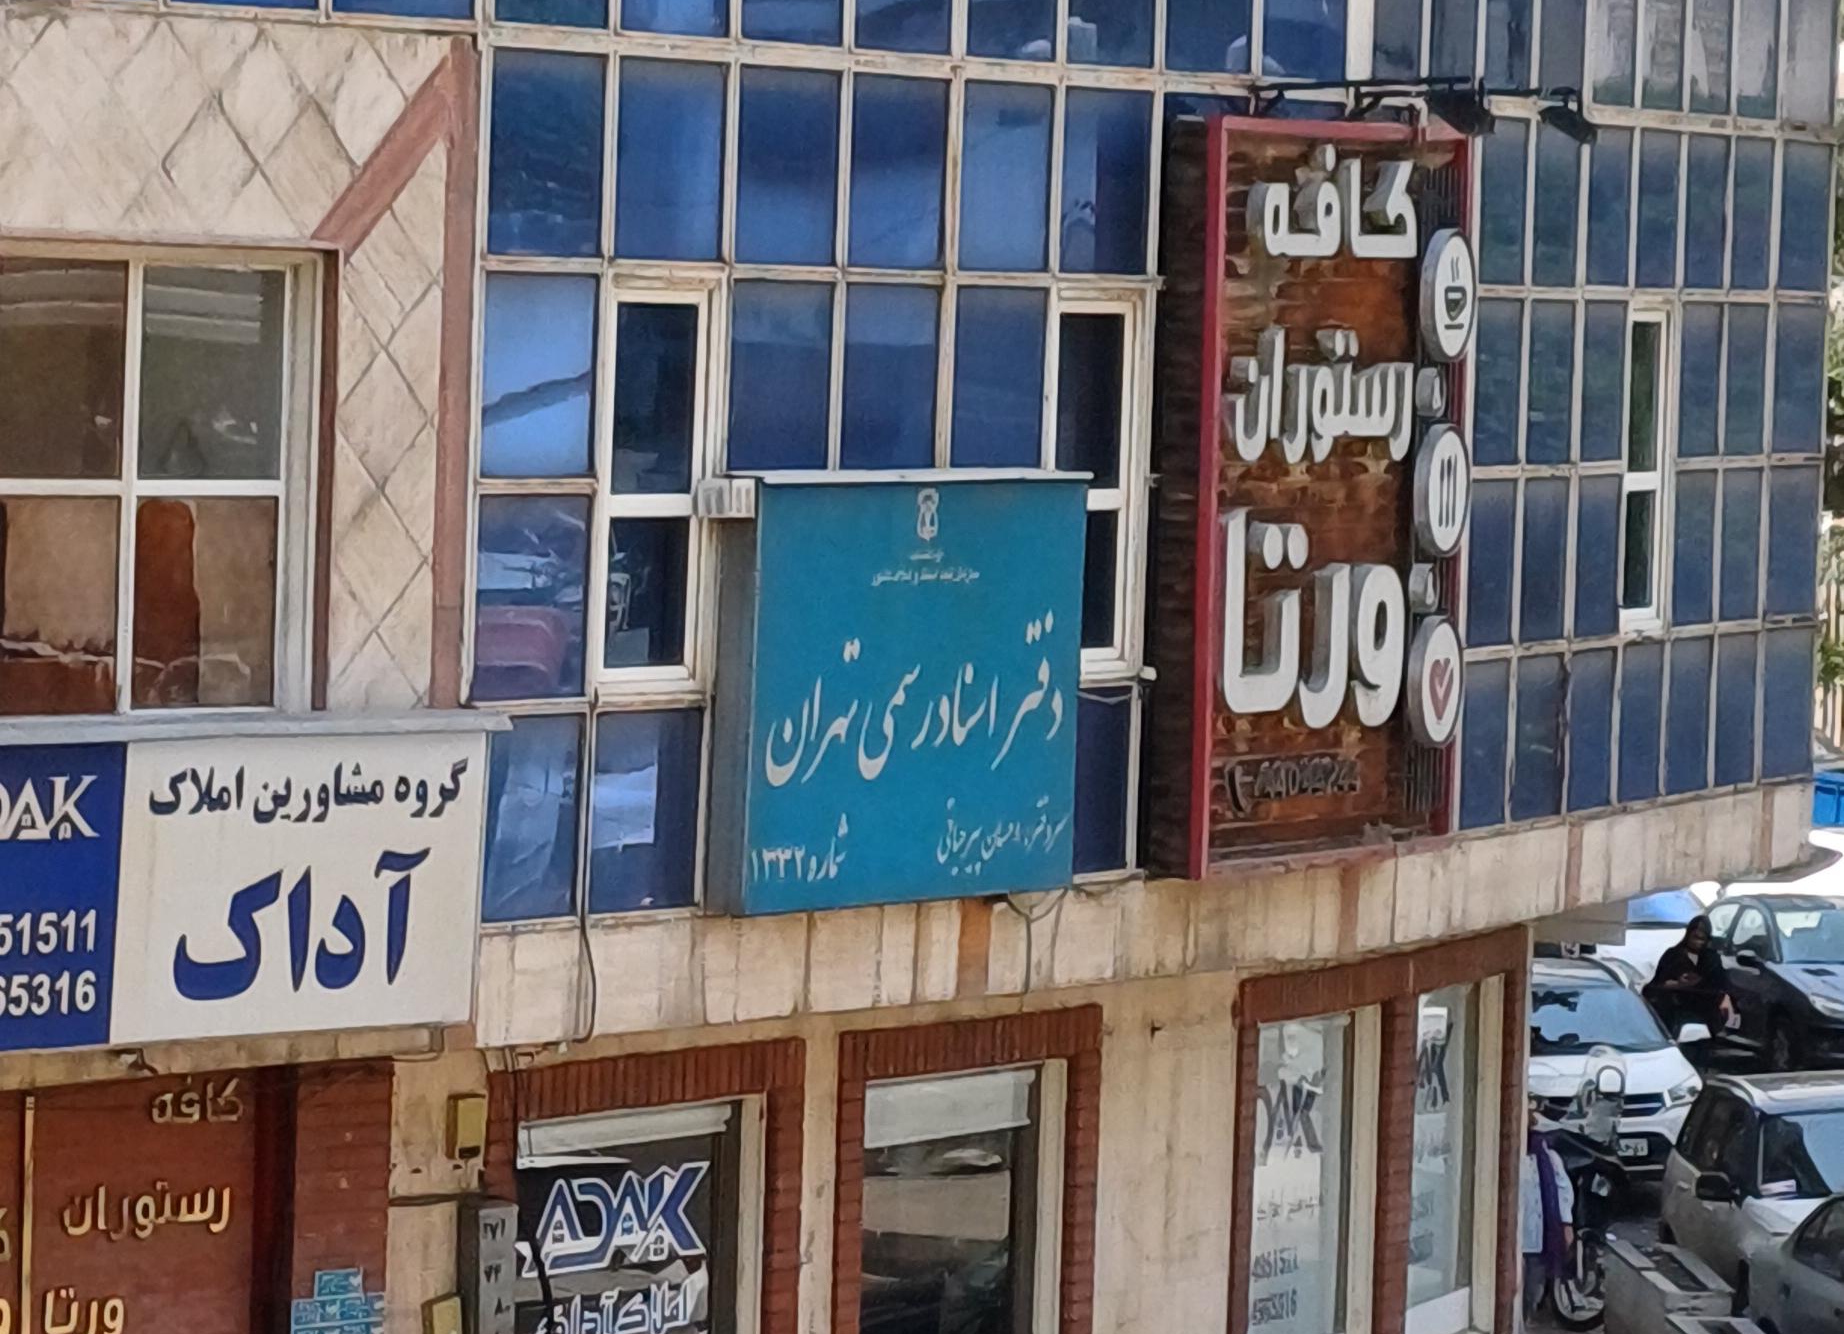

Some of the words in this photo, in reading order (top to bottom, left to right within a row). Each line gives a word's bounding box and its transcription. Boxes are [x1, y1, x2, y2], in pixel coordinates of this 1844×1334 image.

[1247, 142, 1419, 260] کافه
[1227, 326, 1415, 463] رستوران
[1219, 508, 1407, 730] ورتا
[765, 637, 861, 787] تهران
[857, 663, 934, 781] رسمی
[932, 662, 998, 747] اسناد
[990, 608, 1064, 771] دفتر
[149, 764, 245, 815] املاک
[252, 762, 384, 824] مشاورین
[394, 756, 469, 818] گروه
[807, 812, 849, 883] شماره
[173, 847, 431, 1002] آداک
[0, 969, 97, 1017] 5316
[151, 1077, 245, 1124] کافه
[62, 1179, 232, 1242] رستوران
[536, 1161, 711, 1277] ADAK
